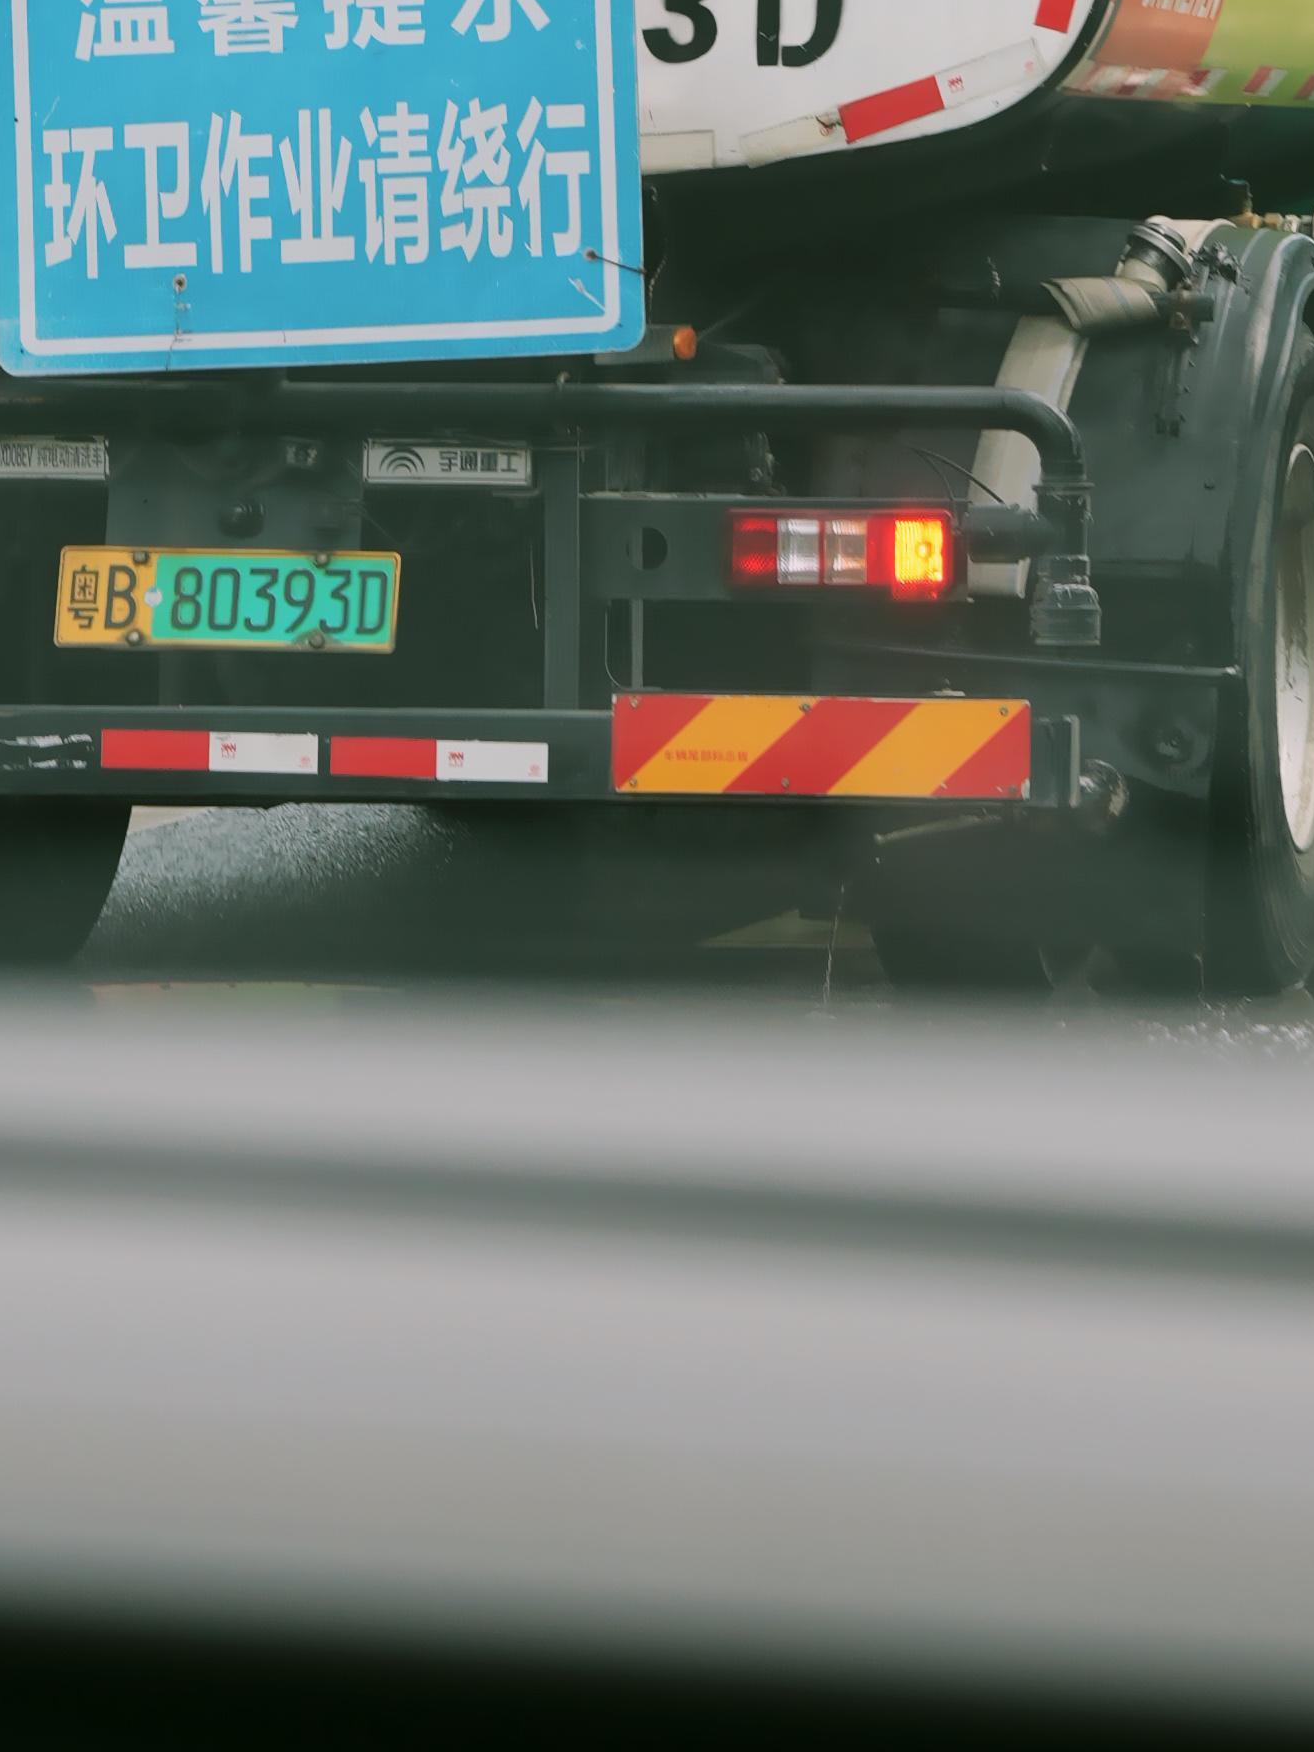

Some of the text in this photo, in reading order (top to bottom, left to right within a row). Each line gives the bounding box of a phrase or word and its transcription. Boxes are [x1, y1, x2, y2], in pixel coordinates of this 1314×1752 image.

[43, 96, 591, 279] 环卫作业请绕行
[170, 565, 389, 636] 80393D
